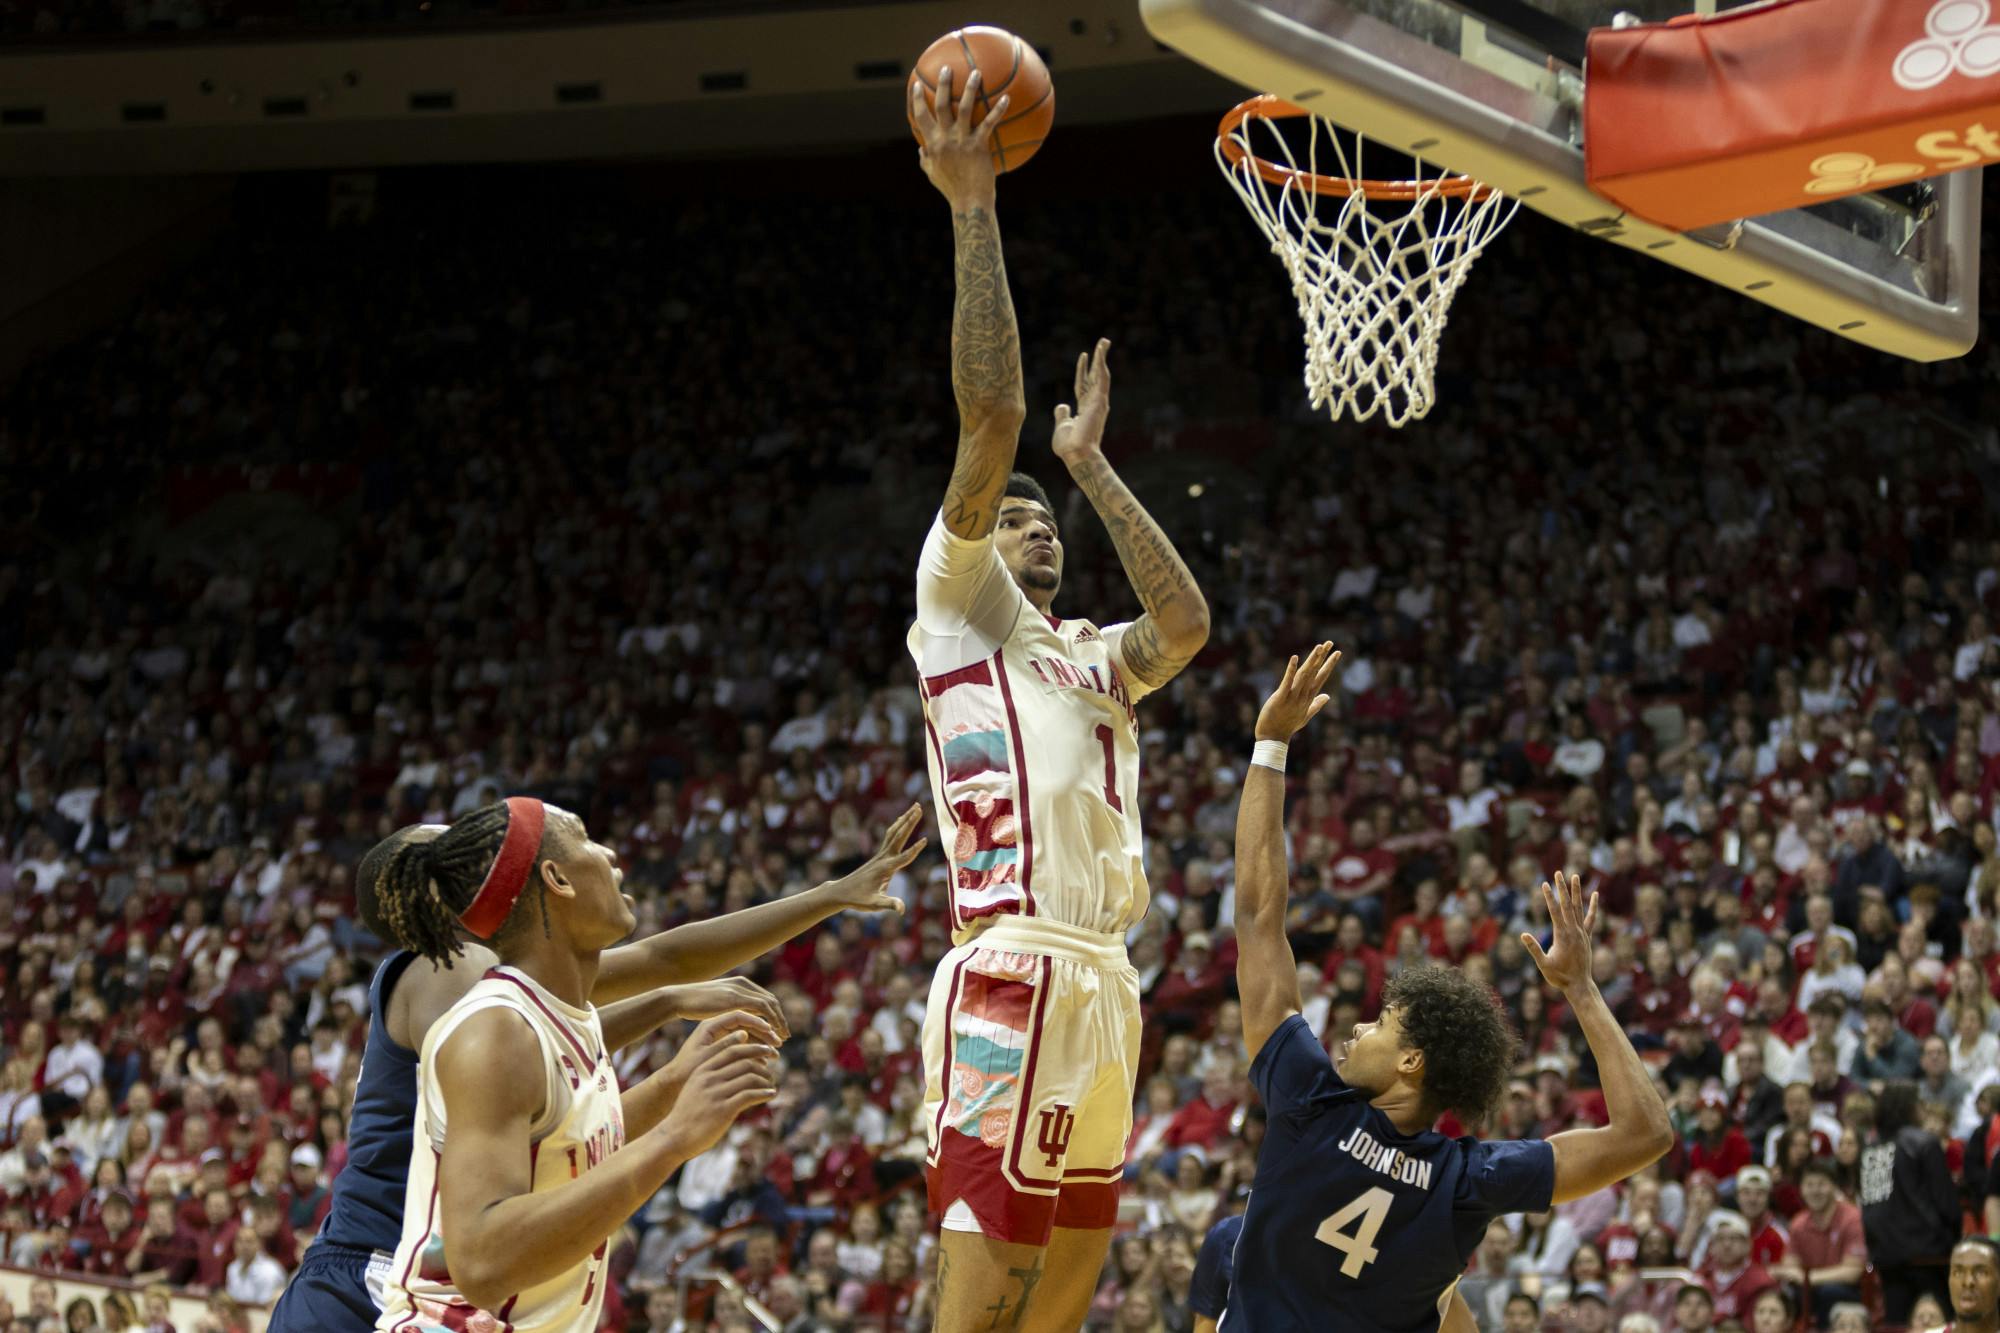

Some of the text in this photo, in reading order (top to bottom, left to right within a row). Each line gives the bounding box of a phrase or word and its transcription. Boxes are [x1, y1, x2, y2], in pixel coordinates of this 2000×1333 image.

[1095, 723, 1124, 815] 1
[1338, 1127, 1433, 1191] JOHNSON
[1314, 1185, 1395, 1280] 4
